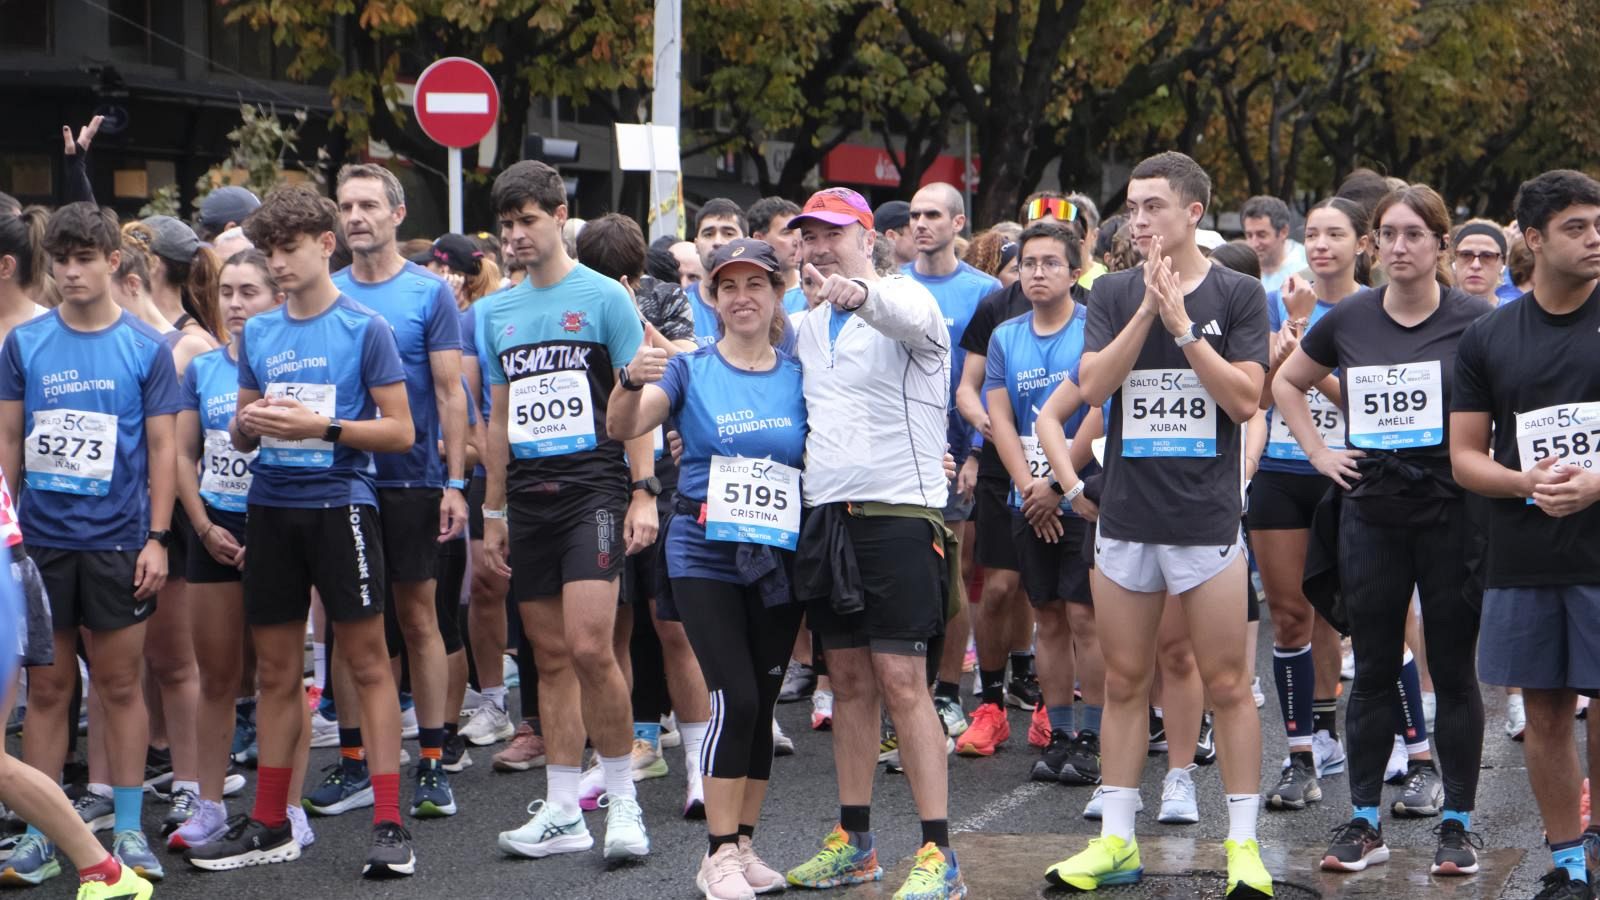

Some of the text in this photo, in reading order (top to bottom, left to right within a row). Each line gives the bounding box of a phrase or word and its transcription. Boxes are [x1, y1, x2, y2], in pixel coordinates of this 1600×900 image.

[265, 350, 296, 367] SALTO
[42, 369, 79, 385] SALTO
[1017, 367, 1046, 381] SALTO
[1355, 375, 1384, 384] SALTO
[43, 379, 115, 398] FOUNDATION
[514, 384, 537, 396] SALTO
[1130, 379, 1158, 388] SALTO
[1132, 397, 1206, 419] 5448
[1364, 389, 1427, 415] 5189
[516, 397, 584, 426] 5009
[716, 409, 754, 425] SALTO
[718, 417, 793, 437] FOUNDATION
[1150, 423, 1187, 432] XUBAN
[1377, 415, 1415, 427] AMÉLIE
[1524, 416, 1554, 430] SALTO
[533, 423, 567, 435] GORKA
[38, 434, 103, 460] 5273
[720, 465, 749, 474] SALTO
[723, 482, 788, 511] 5195
[730, 508, 779, 522] CRISTINA
